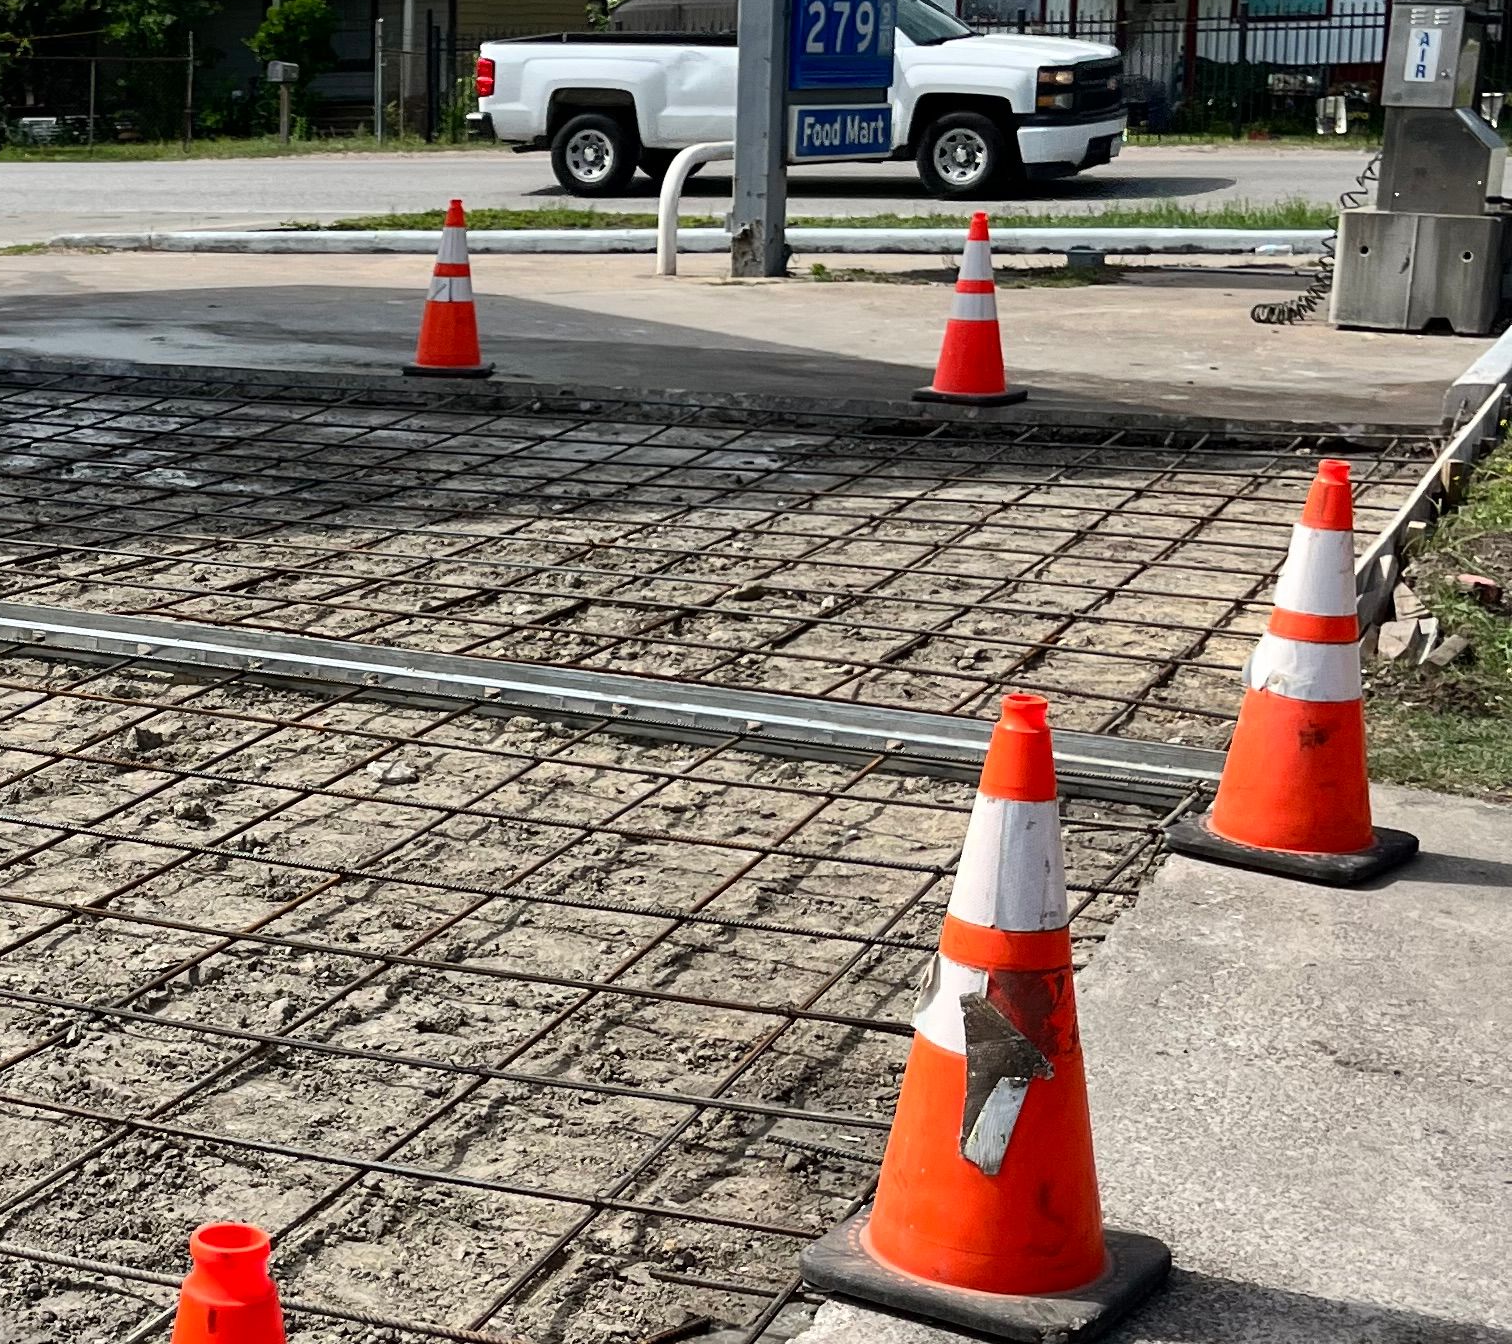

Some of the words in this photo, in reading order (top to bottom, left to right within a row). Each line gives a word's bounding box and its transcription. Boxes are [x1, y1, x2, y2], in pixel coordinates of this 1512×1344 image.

[806, 0, 875, 53] 279
[1415, 31, 1430, 78] AIR
[803, 114, 840, 147] Food
[845, 114, 884, 145] Mart
